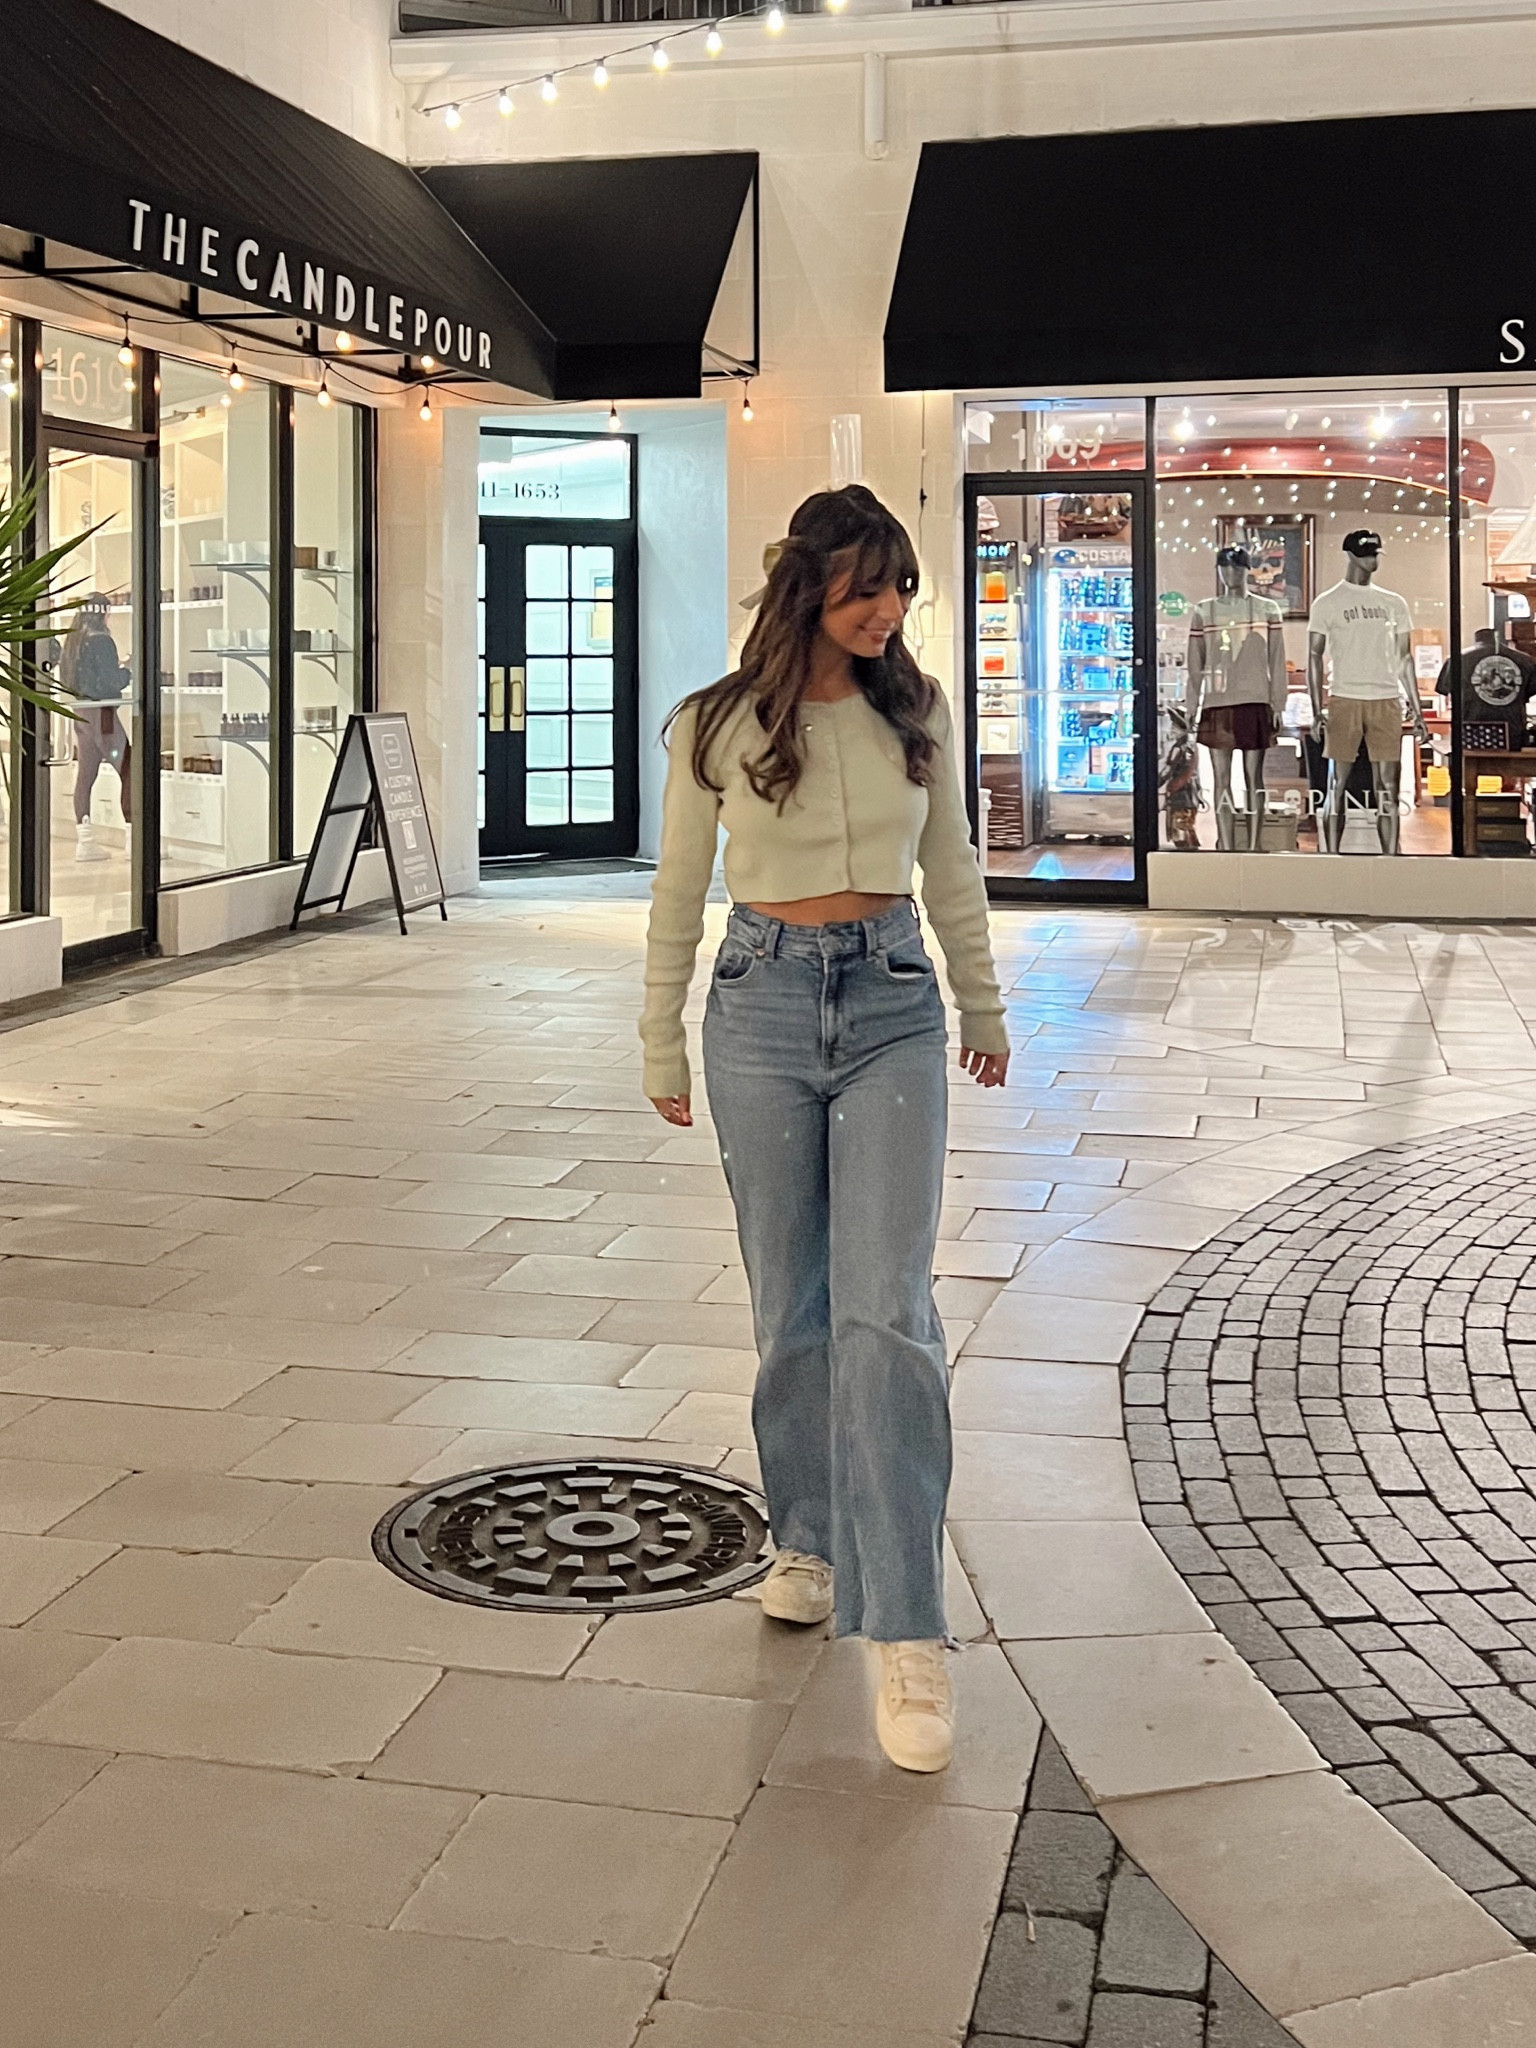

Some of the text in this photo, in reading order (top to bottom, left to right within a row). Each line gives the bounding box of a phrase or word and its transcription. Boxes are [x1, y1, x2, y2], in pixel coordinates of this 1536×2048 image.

[128, 199, 492, 370] THE CANDLE POUR
[1500, 319, 1536, 364] S
[51, 347, 125, 413] 1619
[1079, 549, 1129, 562] COSTA
[1343, 605, 1360, 623] got
[1197, 788, 1412, 816] SALT PINES
